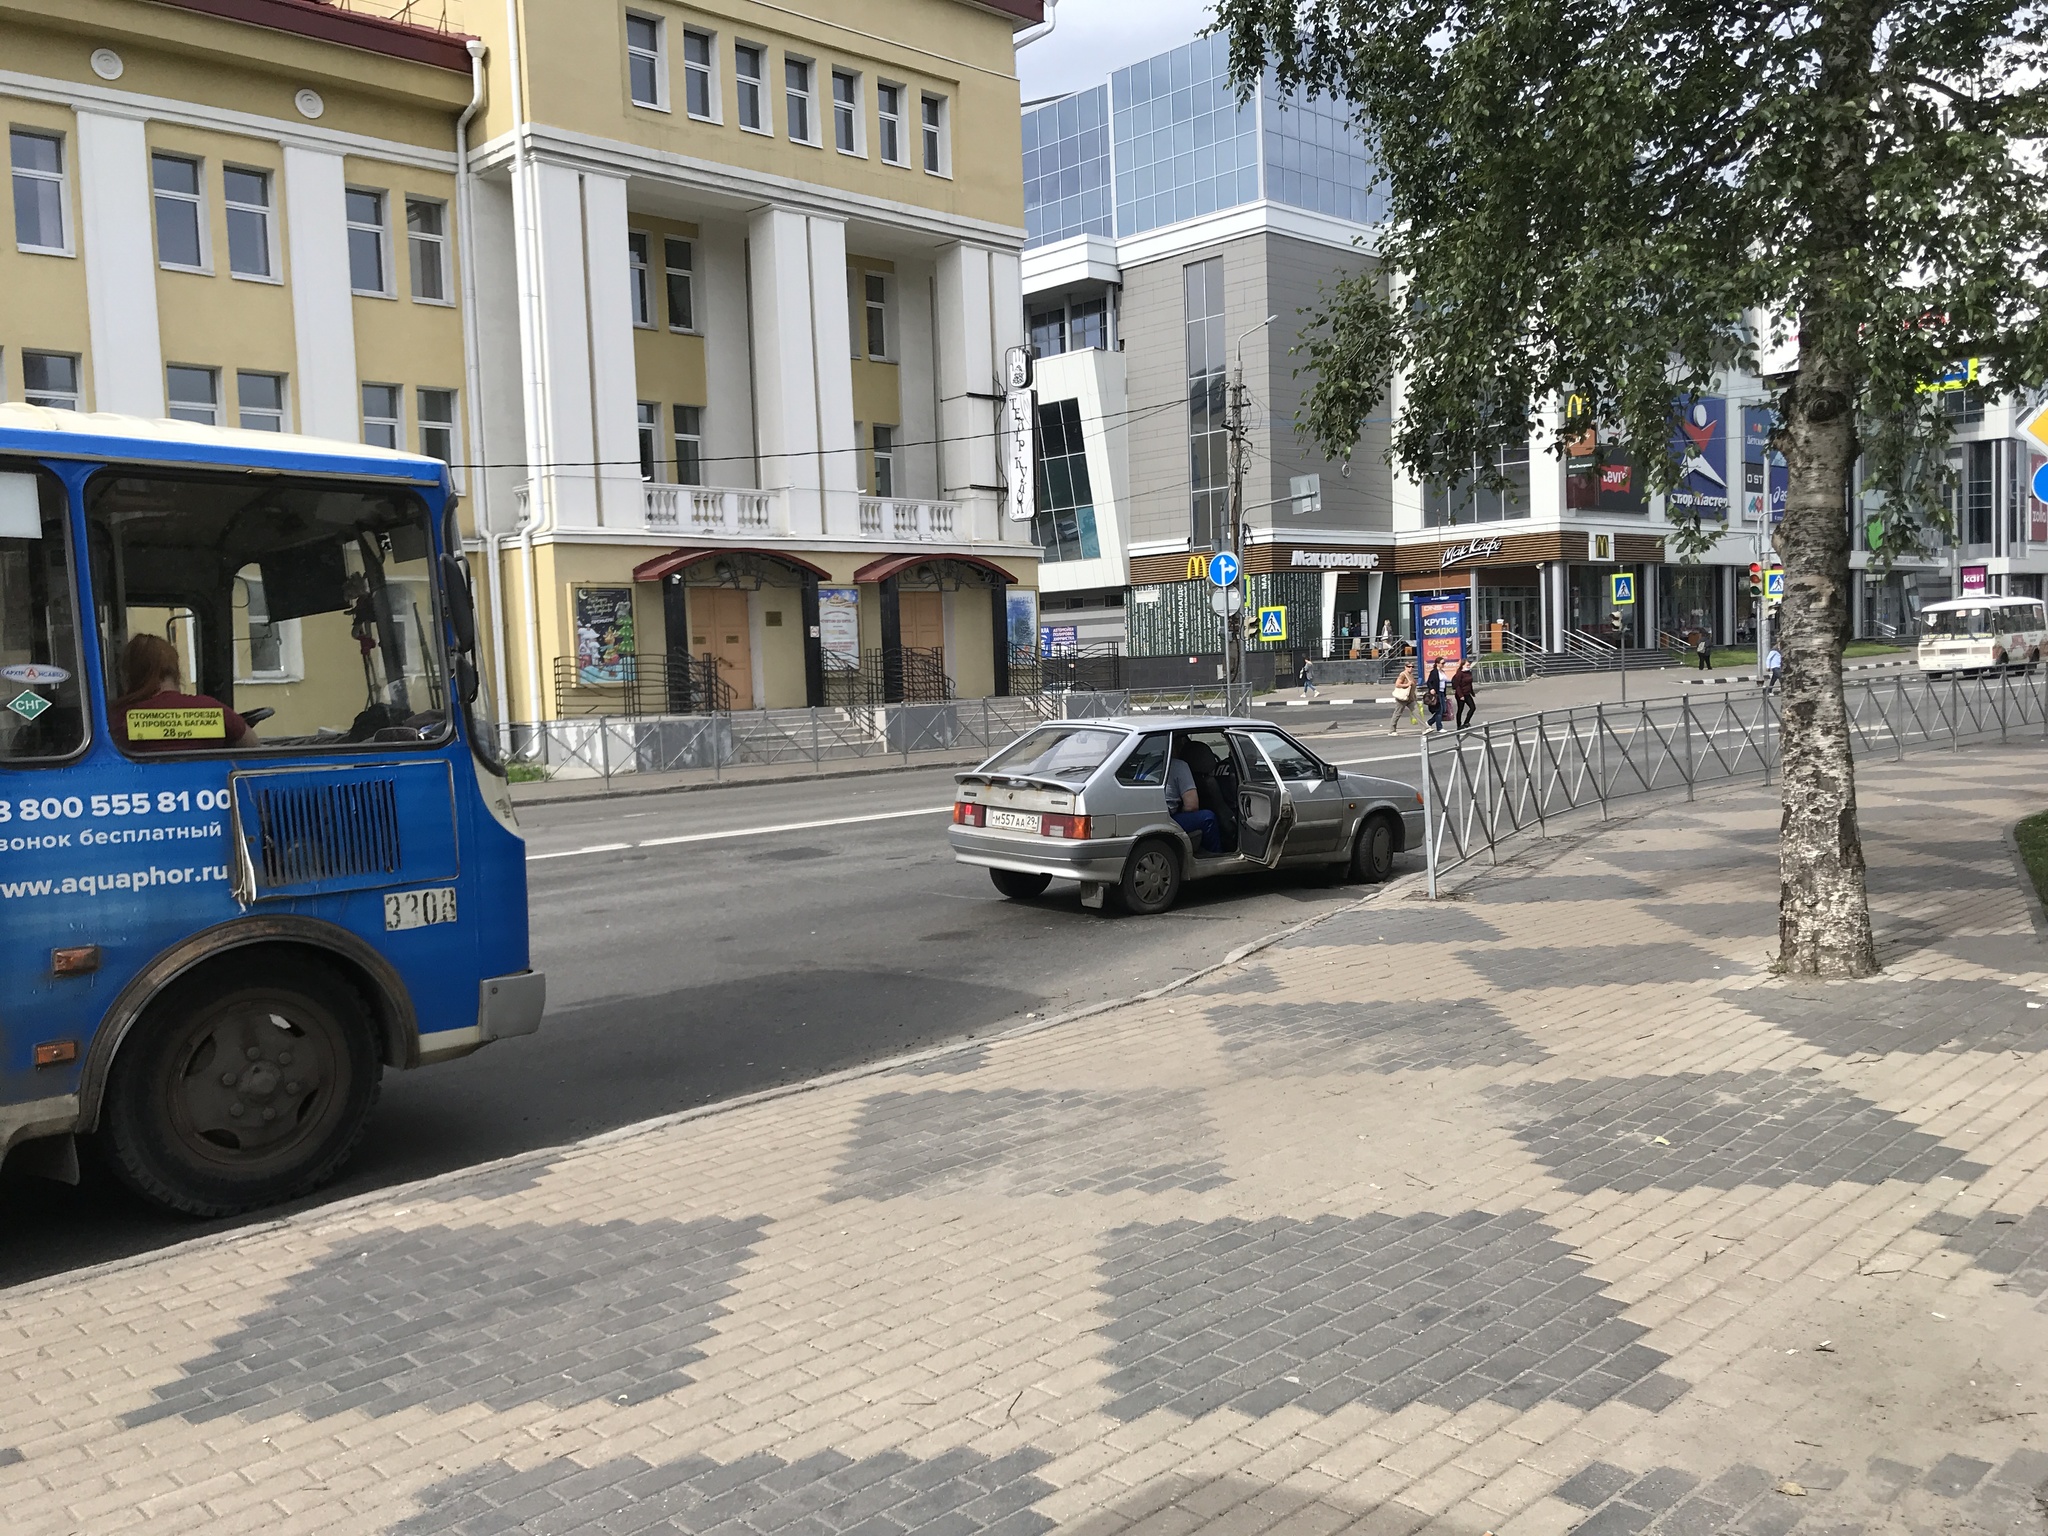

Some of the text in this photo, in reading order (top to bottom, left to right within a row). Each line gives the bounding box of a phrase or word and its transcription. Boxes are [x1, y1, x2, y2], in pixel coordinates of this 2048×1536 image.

[1290, 550, 1379, 568] Макдоналдс
[1424, 617, 1457, 626] КРУТЫЕ
[1424, 628, 1458, 636] СКИДКИ
[16, 700, 42, 710] СНГ
[163, 729, 192, 738] 28 руб
[19, 797, 83, 820] 800
[91, 792, 151, 816] 555
[157, 790, 190, 813] 81
[196, 789, 232, 811] 00
[80, 821, 222, 846] бесплатный
[0, 865, 228, 898] ww.aquaphor.ru
